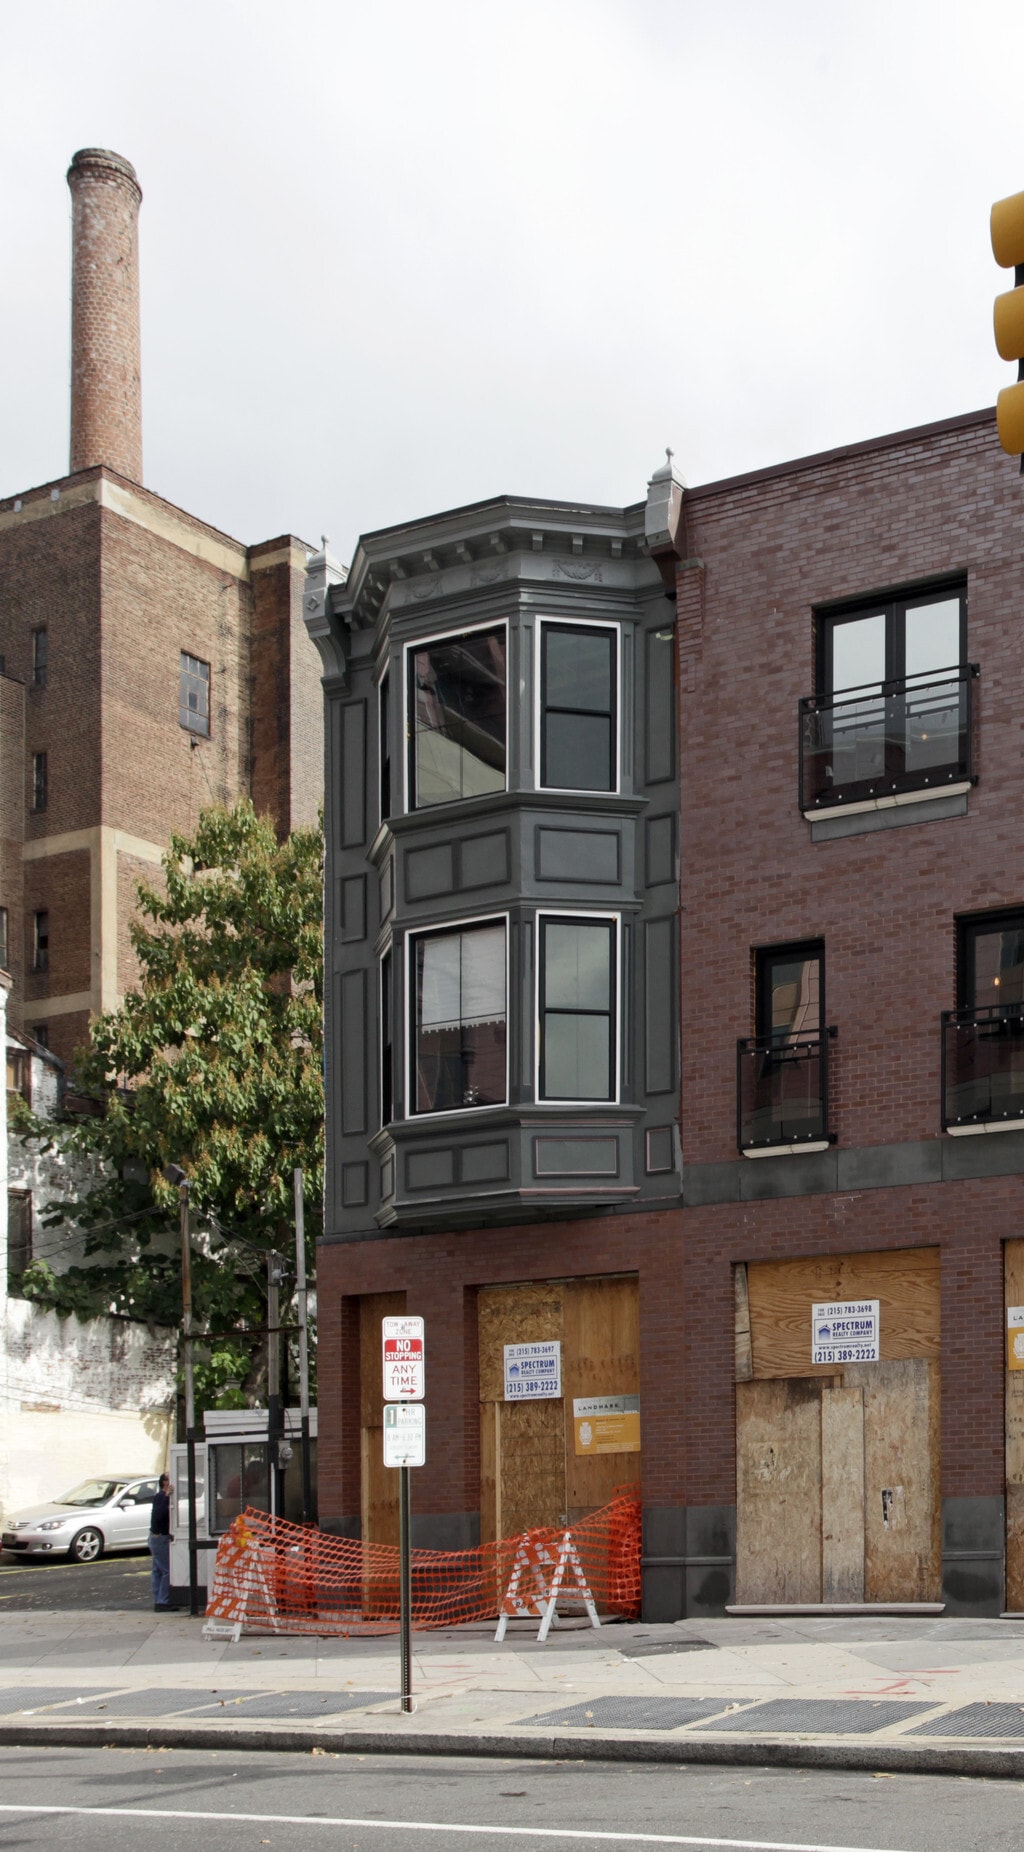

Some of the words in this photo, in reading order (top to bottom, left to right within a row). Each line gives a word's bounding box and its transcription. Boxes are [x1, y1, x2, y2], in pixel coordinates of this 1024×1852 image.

[827, 1306, 843, 1316] (215)
[844, 1304, 872, 1314] 783-3698
[832, 1320, 873, 1332] SPECTRUM
[396, 1339, 411, 1352] NO
[385, 1351, 422, 1361] STOPPING
[814, 1350, 835, 1363] (215)
[837, 1348, 876, 1361] 389-2222
[392, 1364, 416, 1374] ANY
[520, 1360, 555, 1370] SPECTRUM
[390, 1376, 418, 1386] TIME
[506, 1382, 524, 1394] (215)
[525, 1380, 558, 1392] 389-2222
[389, 1410, 394, 1425] 1
